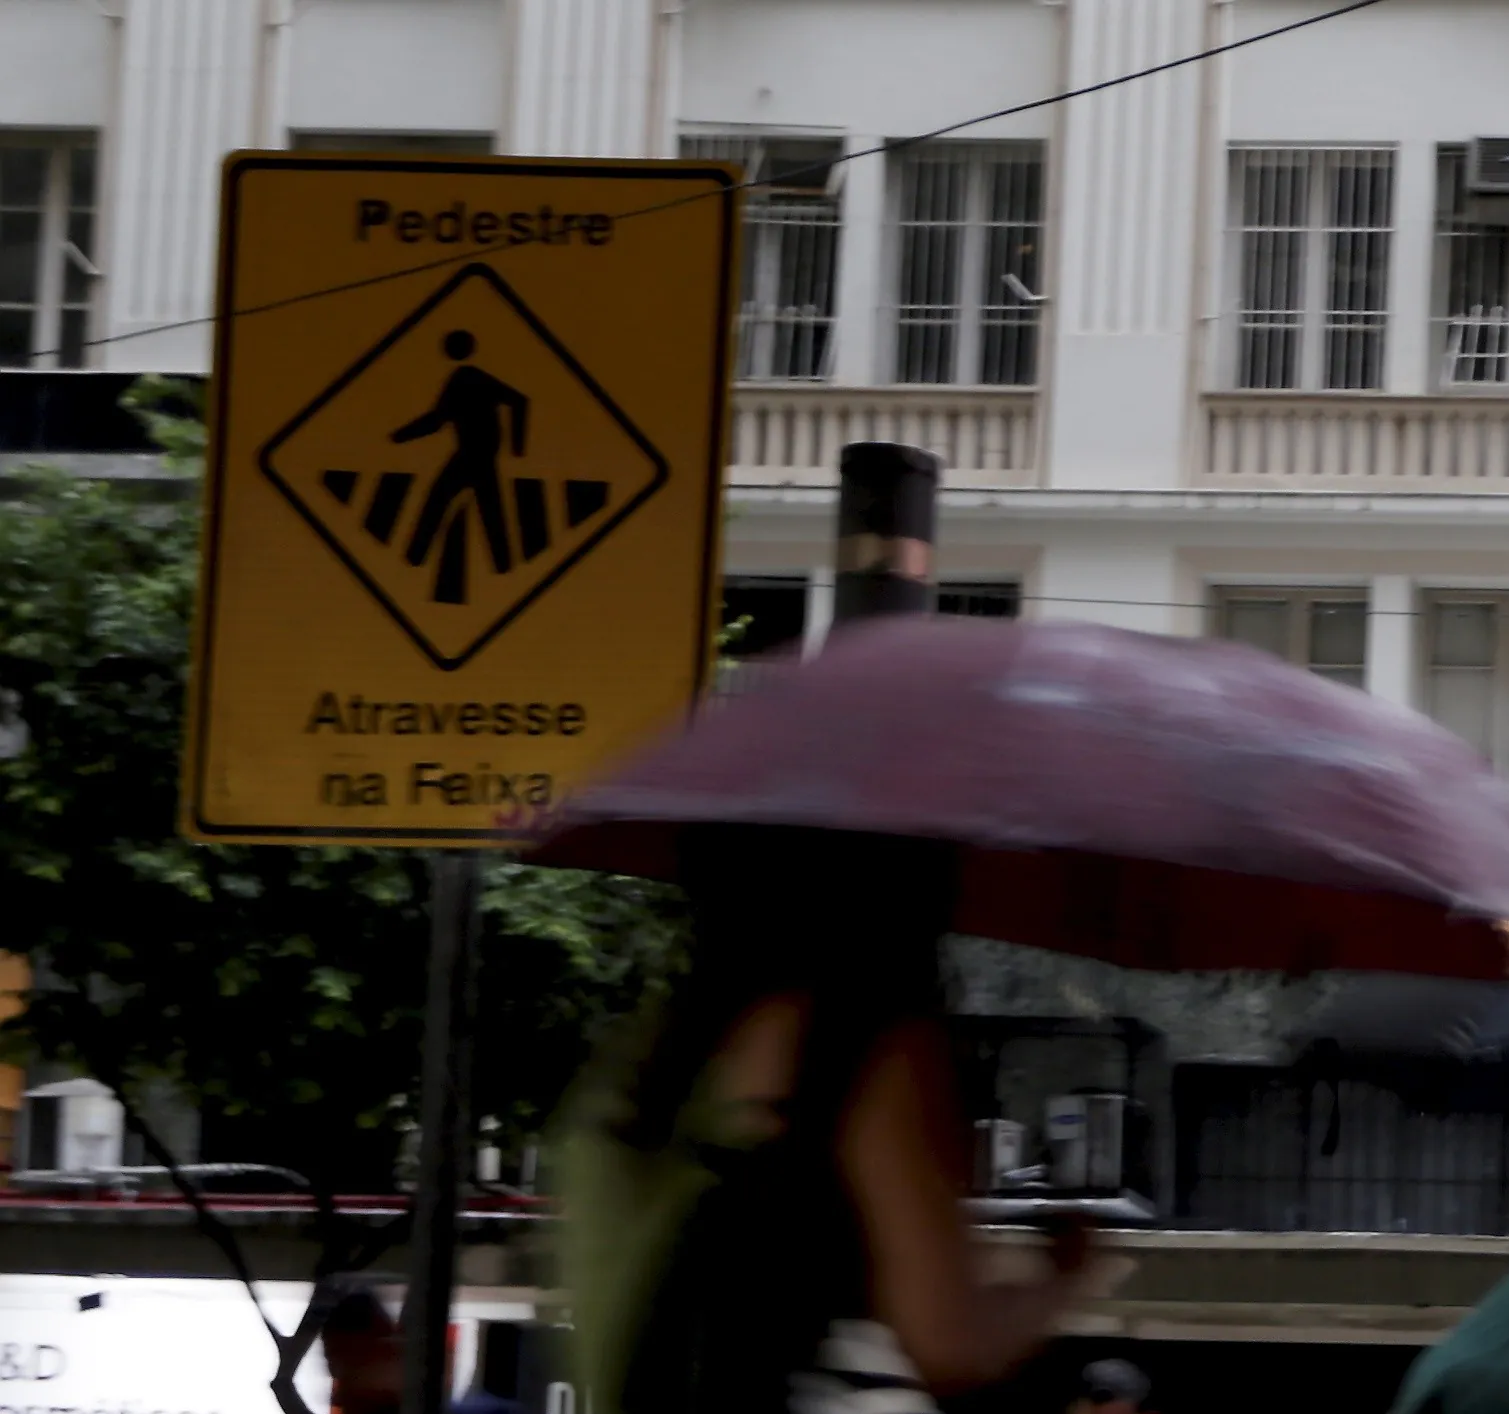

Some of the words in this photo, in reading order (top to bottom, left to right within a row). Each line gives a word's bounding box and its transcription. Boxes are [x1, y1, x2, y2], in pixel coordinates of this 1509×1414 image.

[356, 199, 613, 246] Pedestre
[305, 692, 586, 735] Atravesse
[320, 772, 388, 805] na
[412, 762, 552, 805] Faixa
